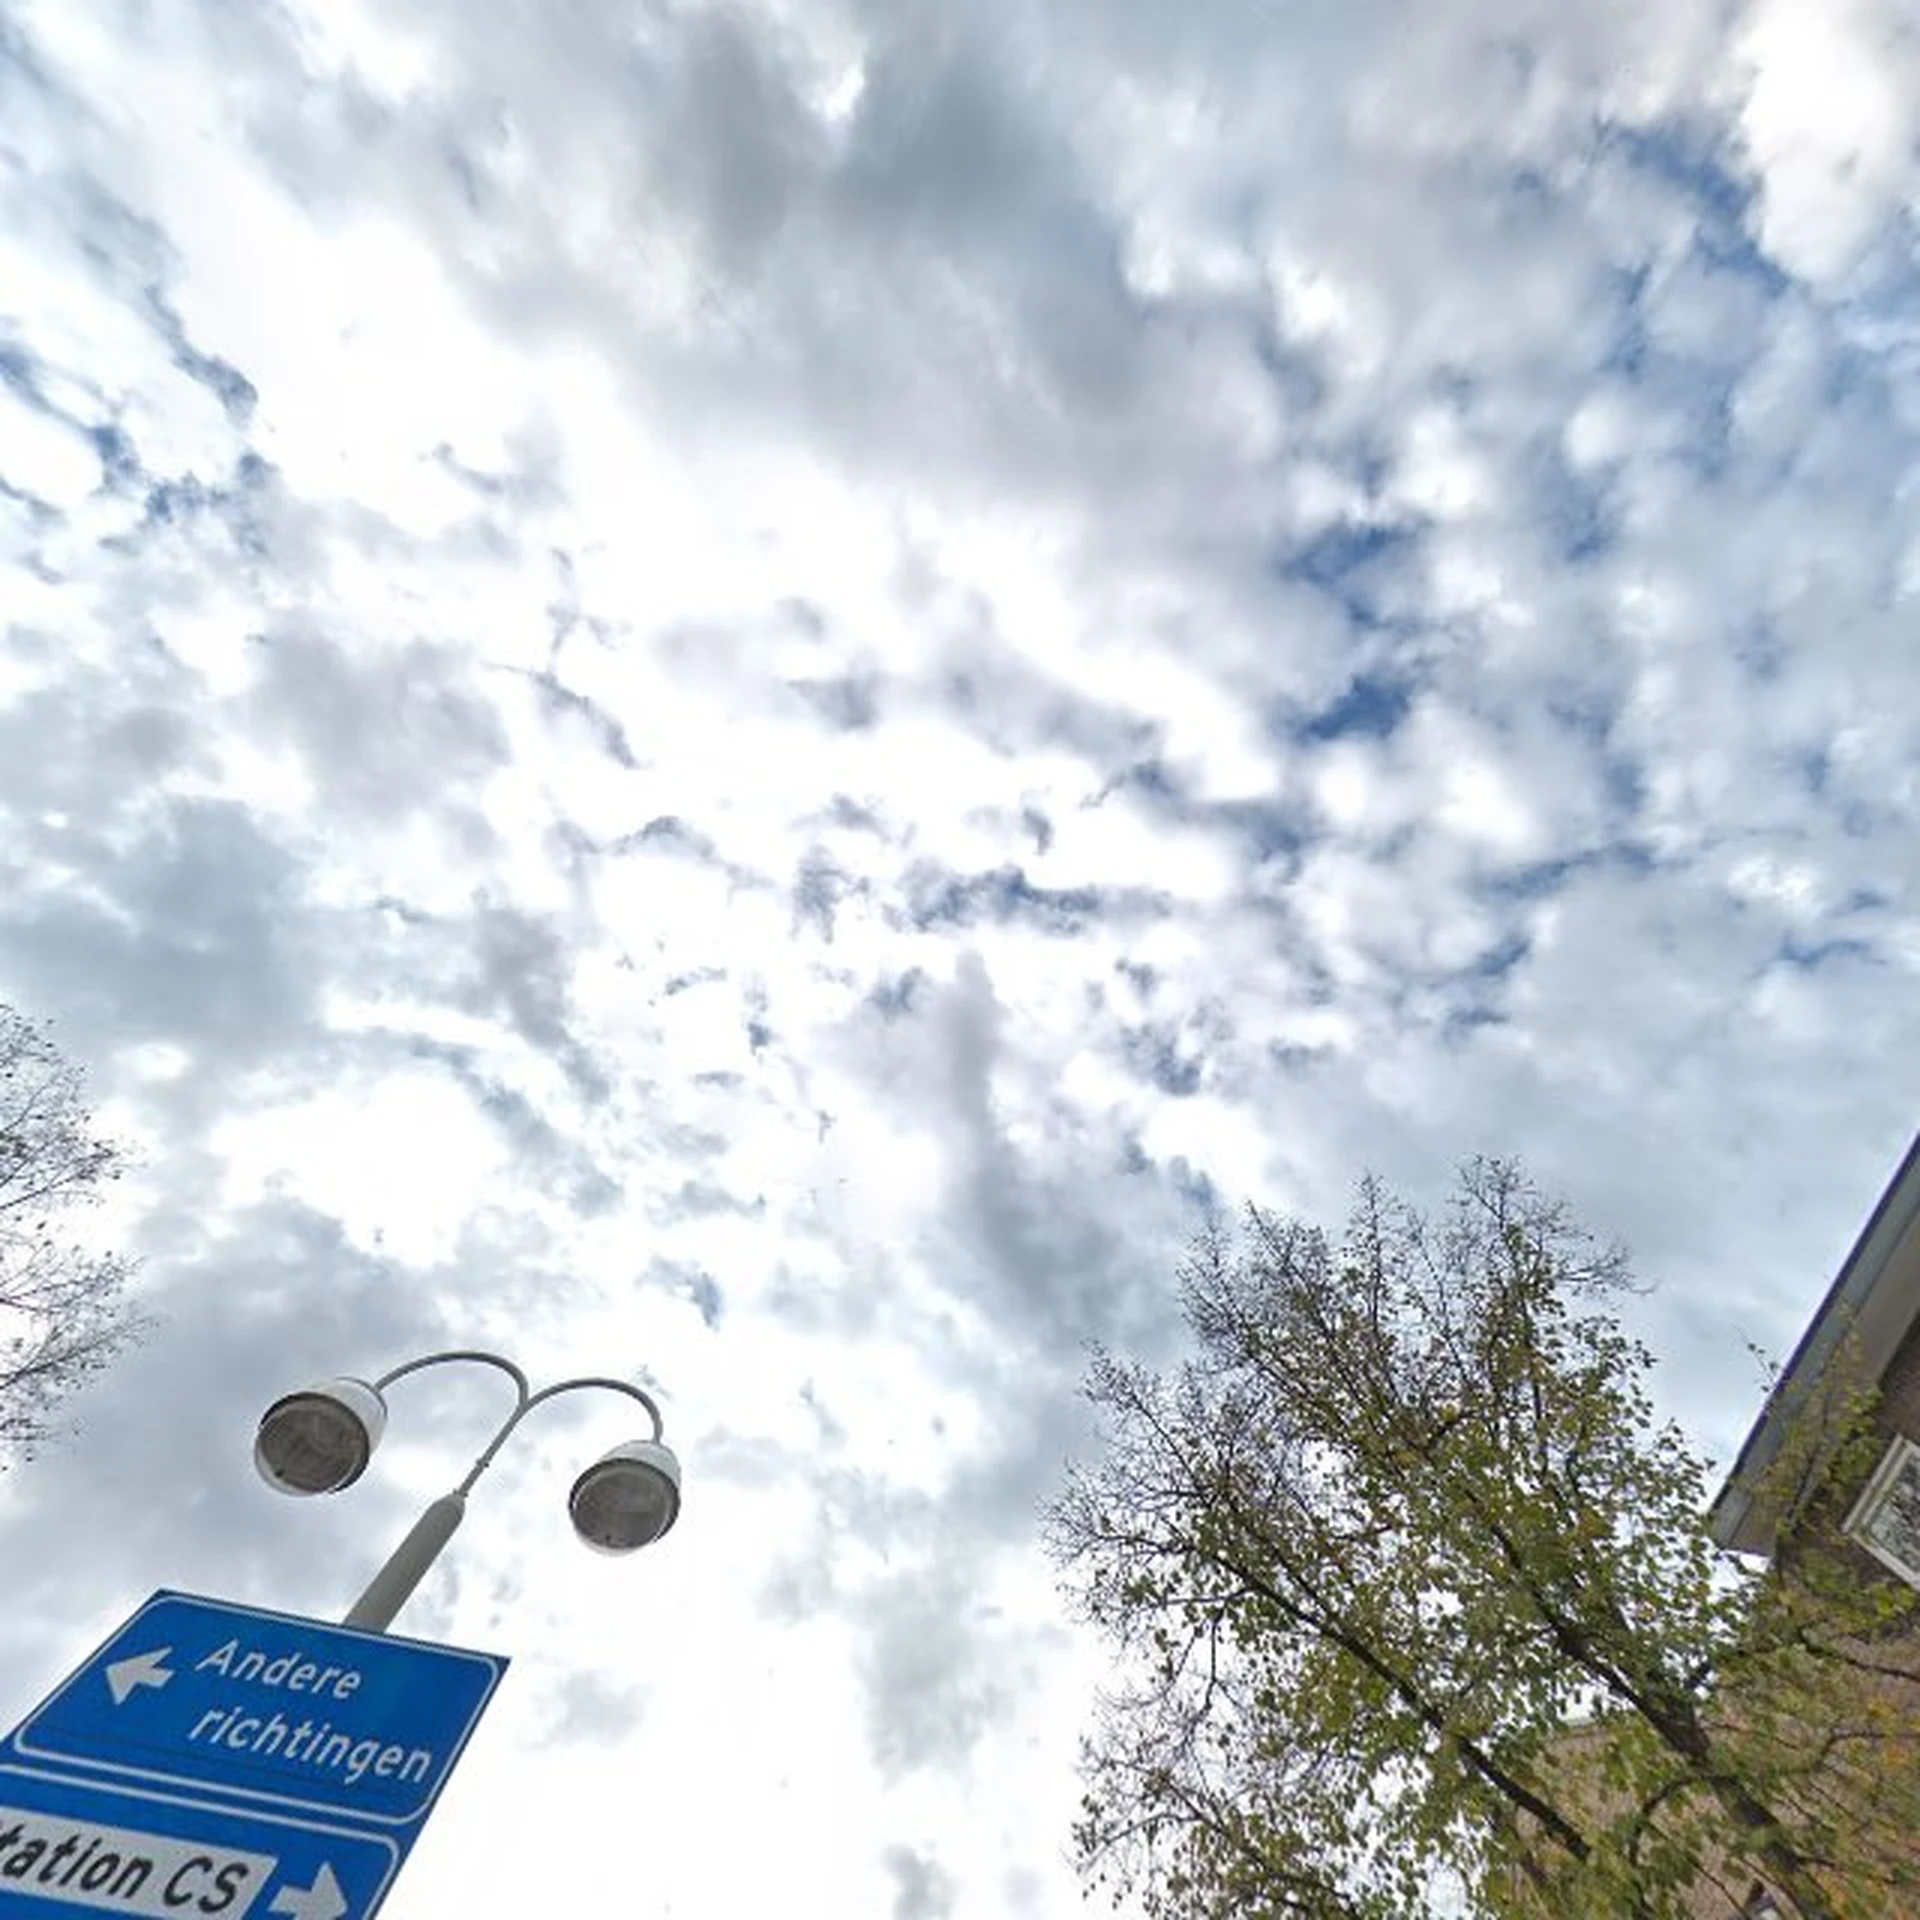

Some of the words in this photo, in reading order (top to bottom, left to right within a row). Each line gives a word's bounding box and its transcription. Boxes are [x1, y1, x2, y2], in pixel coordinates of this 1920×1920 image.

[195, 1638, 361, 1698] Andere
[189, 1706, 432, 1784] richtingen
[162, 1857, 249, 1912] CS
